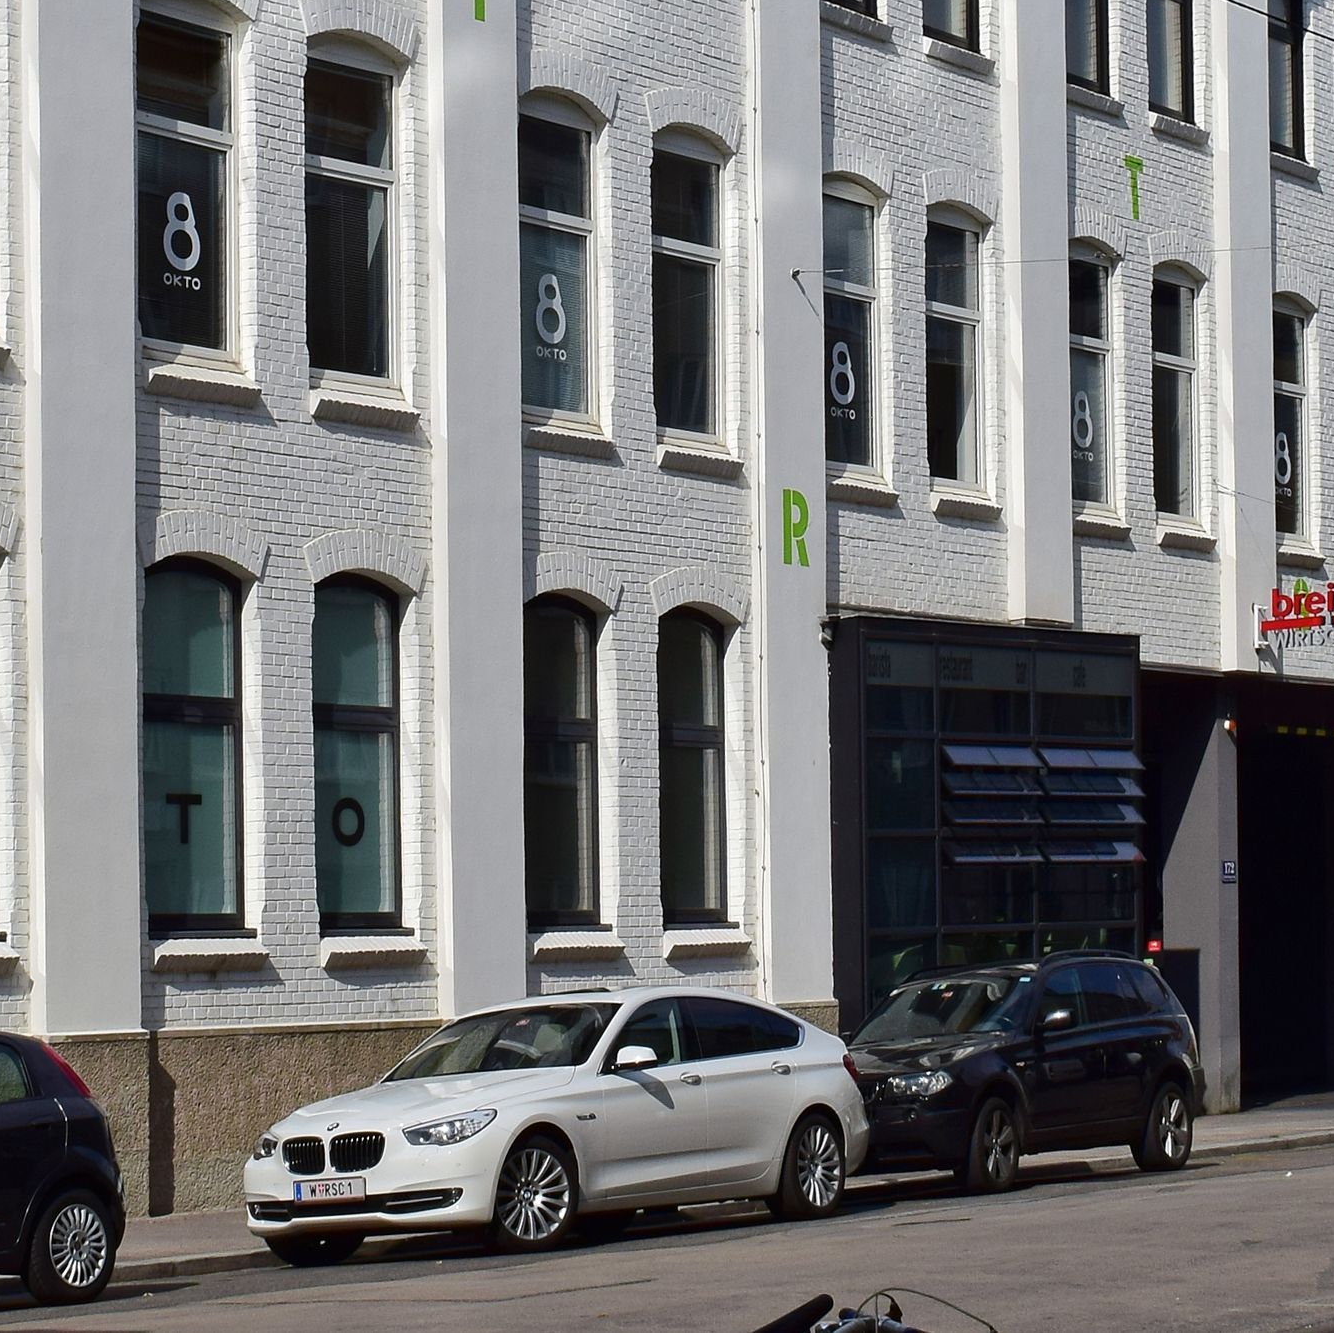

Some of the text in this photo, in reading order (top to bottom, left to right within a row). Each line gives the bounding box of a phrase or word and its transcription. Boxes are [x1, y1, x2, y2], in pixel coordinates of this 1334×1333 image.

[163, 273, 202, 292] OKTO
[535, 346, 567, 362] OKTO
[829, 407, 857, 423] OKTO
[1072, 449, 1095, 463] OKTO
[782, 487, 811, 568] R
